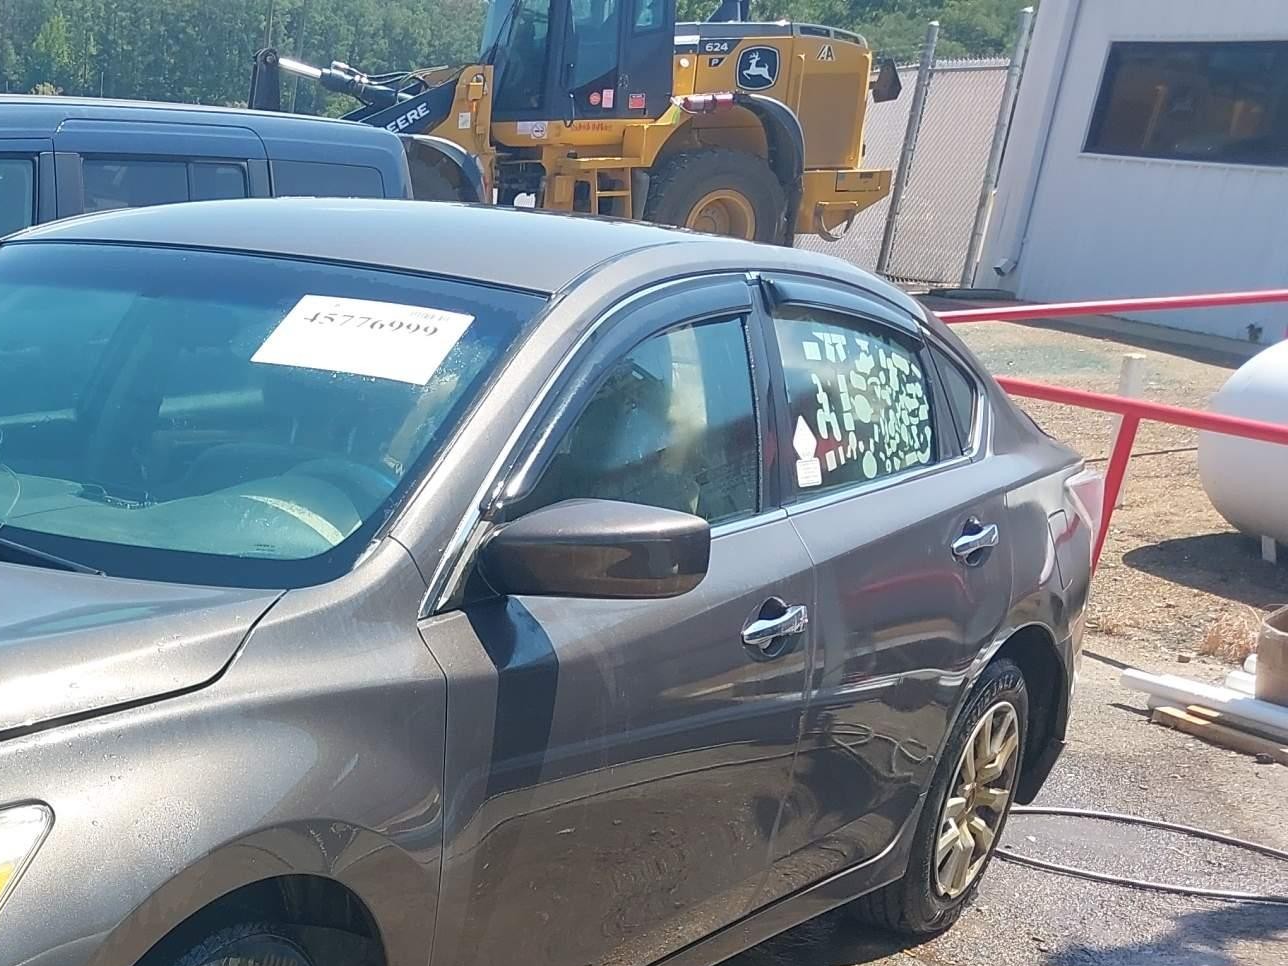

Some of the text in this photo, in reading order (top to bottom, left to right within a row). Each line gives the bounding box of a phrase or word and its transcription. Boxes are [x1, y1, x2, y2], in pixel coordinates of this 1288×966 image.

[705, 42, 728, 52] 624
[386, 102, 430, 134] EERE
[304, 311, 439, 337] 45776999
